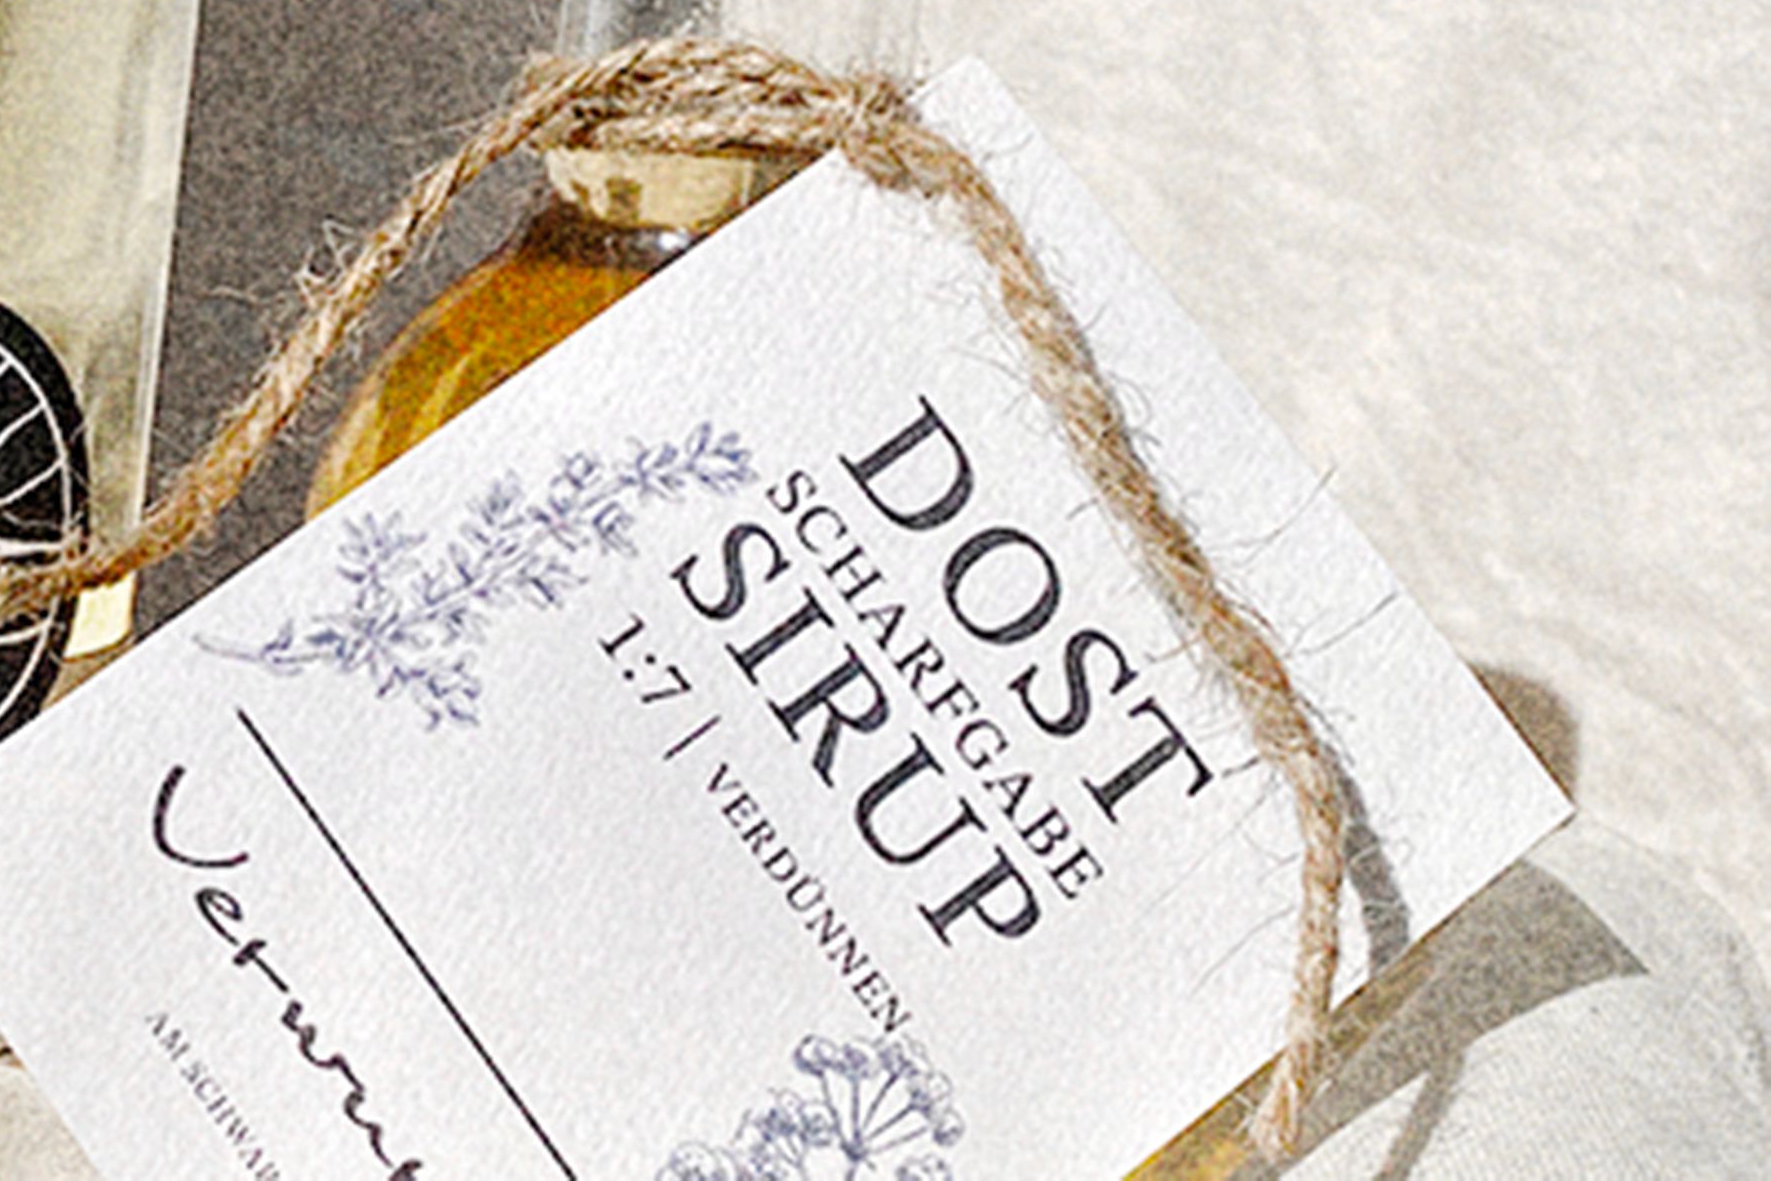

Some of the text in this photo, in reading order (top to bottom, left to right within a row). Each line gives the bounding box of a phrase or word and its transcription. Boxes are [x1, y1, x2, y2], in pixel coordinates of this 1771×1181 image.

[671, 523, 1043, 947] SIRUP
[766, 469, 1105, 901] SCHARFGABE
[839, 395, 1214, 825] DOST
[600, 614, 692, 706] 1:7
[705, 763, 913, 1035] VERDÜNNEN
[145, 1013, 190, 1062] AM
